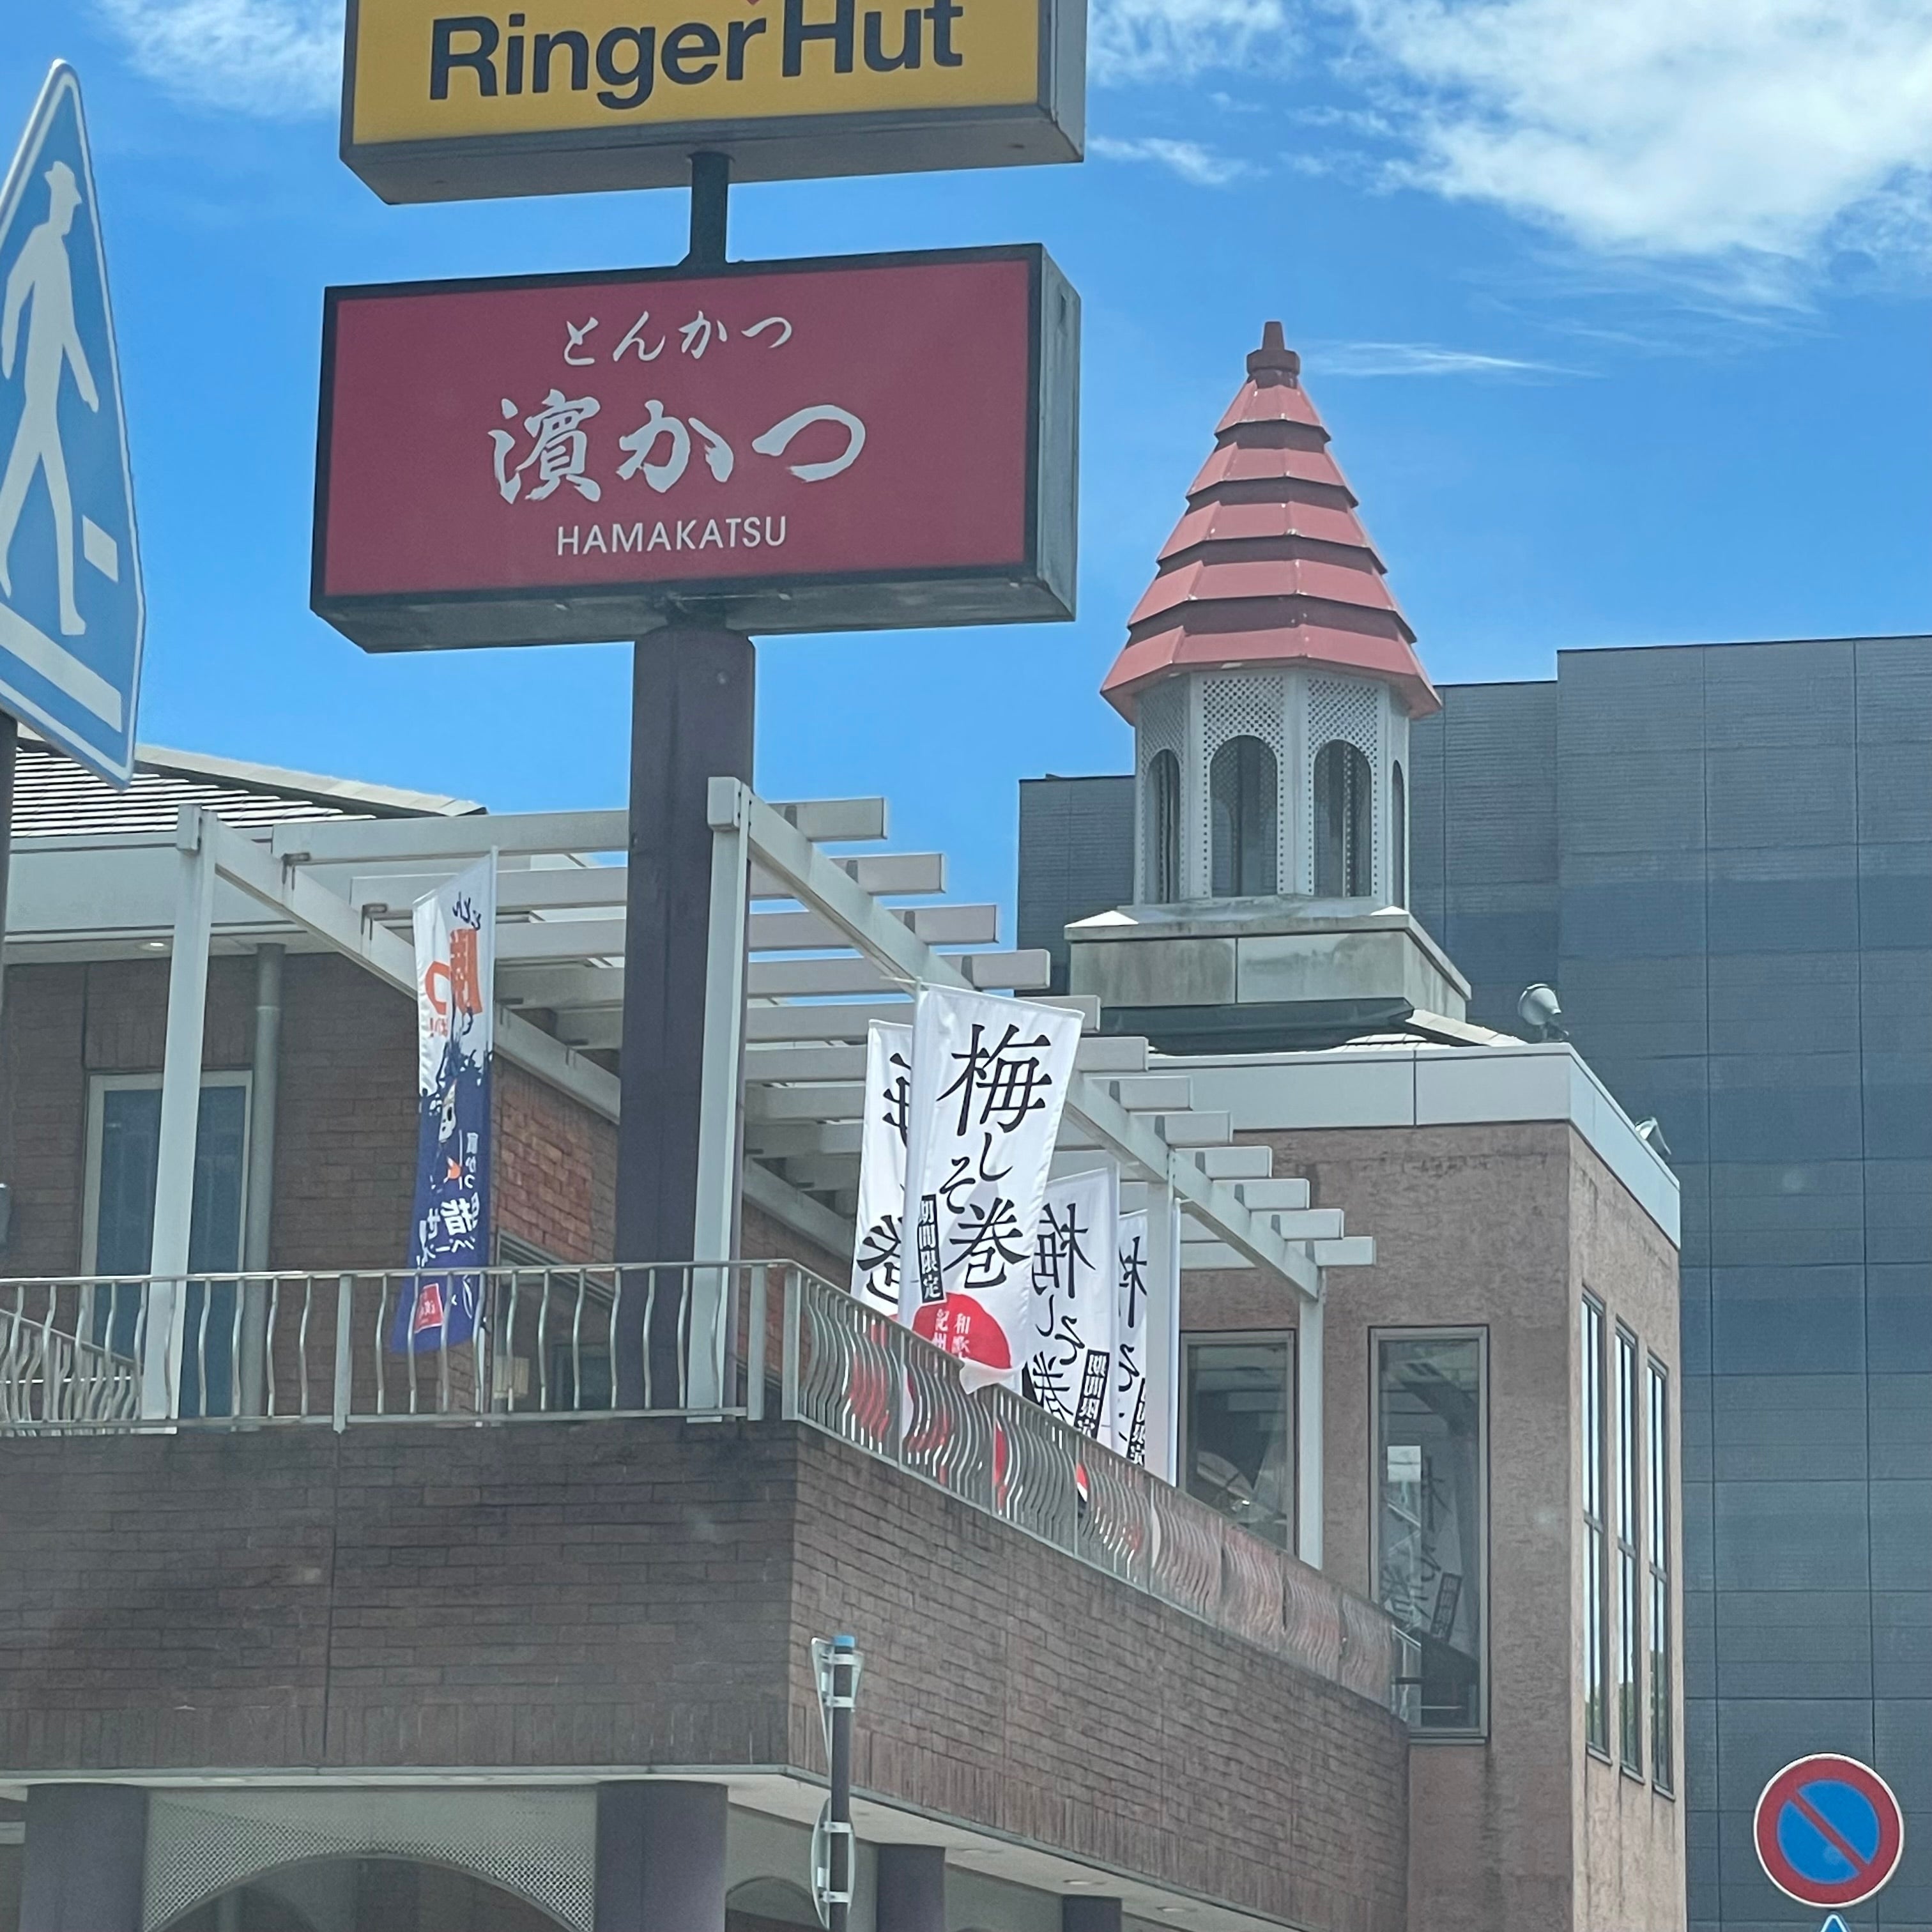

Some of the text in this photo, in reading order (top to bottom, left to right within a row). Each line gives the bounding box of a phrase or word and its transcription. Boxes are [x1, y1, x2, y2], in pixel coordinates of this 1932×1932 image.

[430, 0, 963, 110] Ringer Hut
[564, 310, 793, 366] とんかつ
[487, 388, 866, 504] 濱かつ
[556, 516, 788, 556] HAMAKATSU
